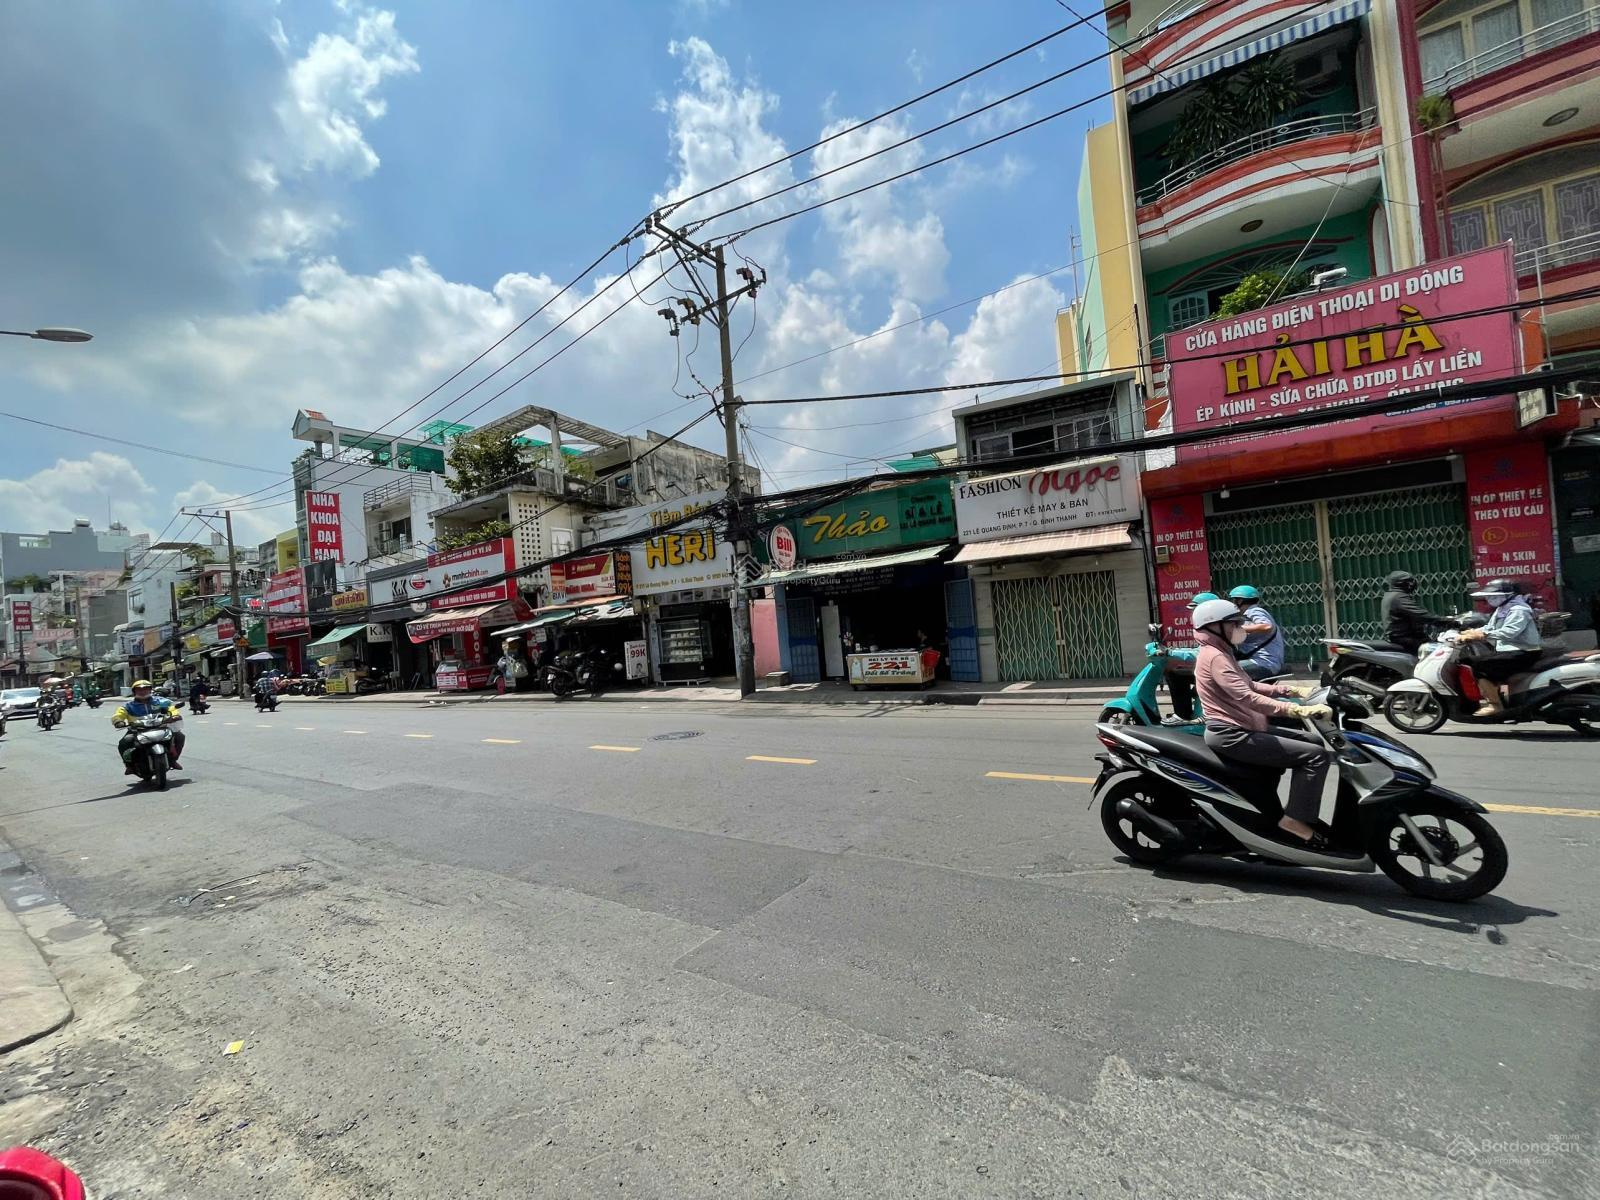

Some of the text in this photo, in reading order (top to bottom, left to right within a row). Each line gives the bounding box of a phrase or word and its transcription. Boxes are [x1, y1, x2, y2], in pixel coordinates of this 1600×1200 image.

[1185, 265, 1464, 351] CỬA HÀNG ĐIỆN THOẠI DI ĐỘNG
[1222, 304, 1444, 396] HẢI HÀ
[1196, 405, 1214, 422] ÉP
[1219, 397, 1256, 418] KÍNH
[1270, 386, 1301, 407] SỬA
[1305, 378, 1349, 399] CHỮA
[1402, 357, 1434, 380] LẤY
[1440, 347, 1482, 373] LIỀN
[958, 475, 1023, 499] FASHION
[312, 493, 336, 507] NHA
[1038, 502, 1057, 514] MAY
[1474, 509, 1500, 521] THEO
[310, 511, 340, 526] KHOA
[802, 510, 890, 543] Thảo
[317, 530, 336, 545] ĐẠI
[776, 536, 792, 552] Bill
[313, 548, 340, 561] NAM
[646, 528, 716, 569] HERI
[1512, 550, 1536, 561] SKIN
[868, 660, 911, 670] 221
